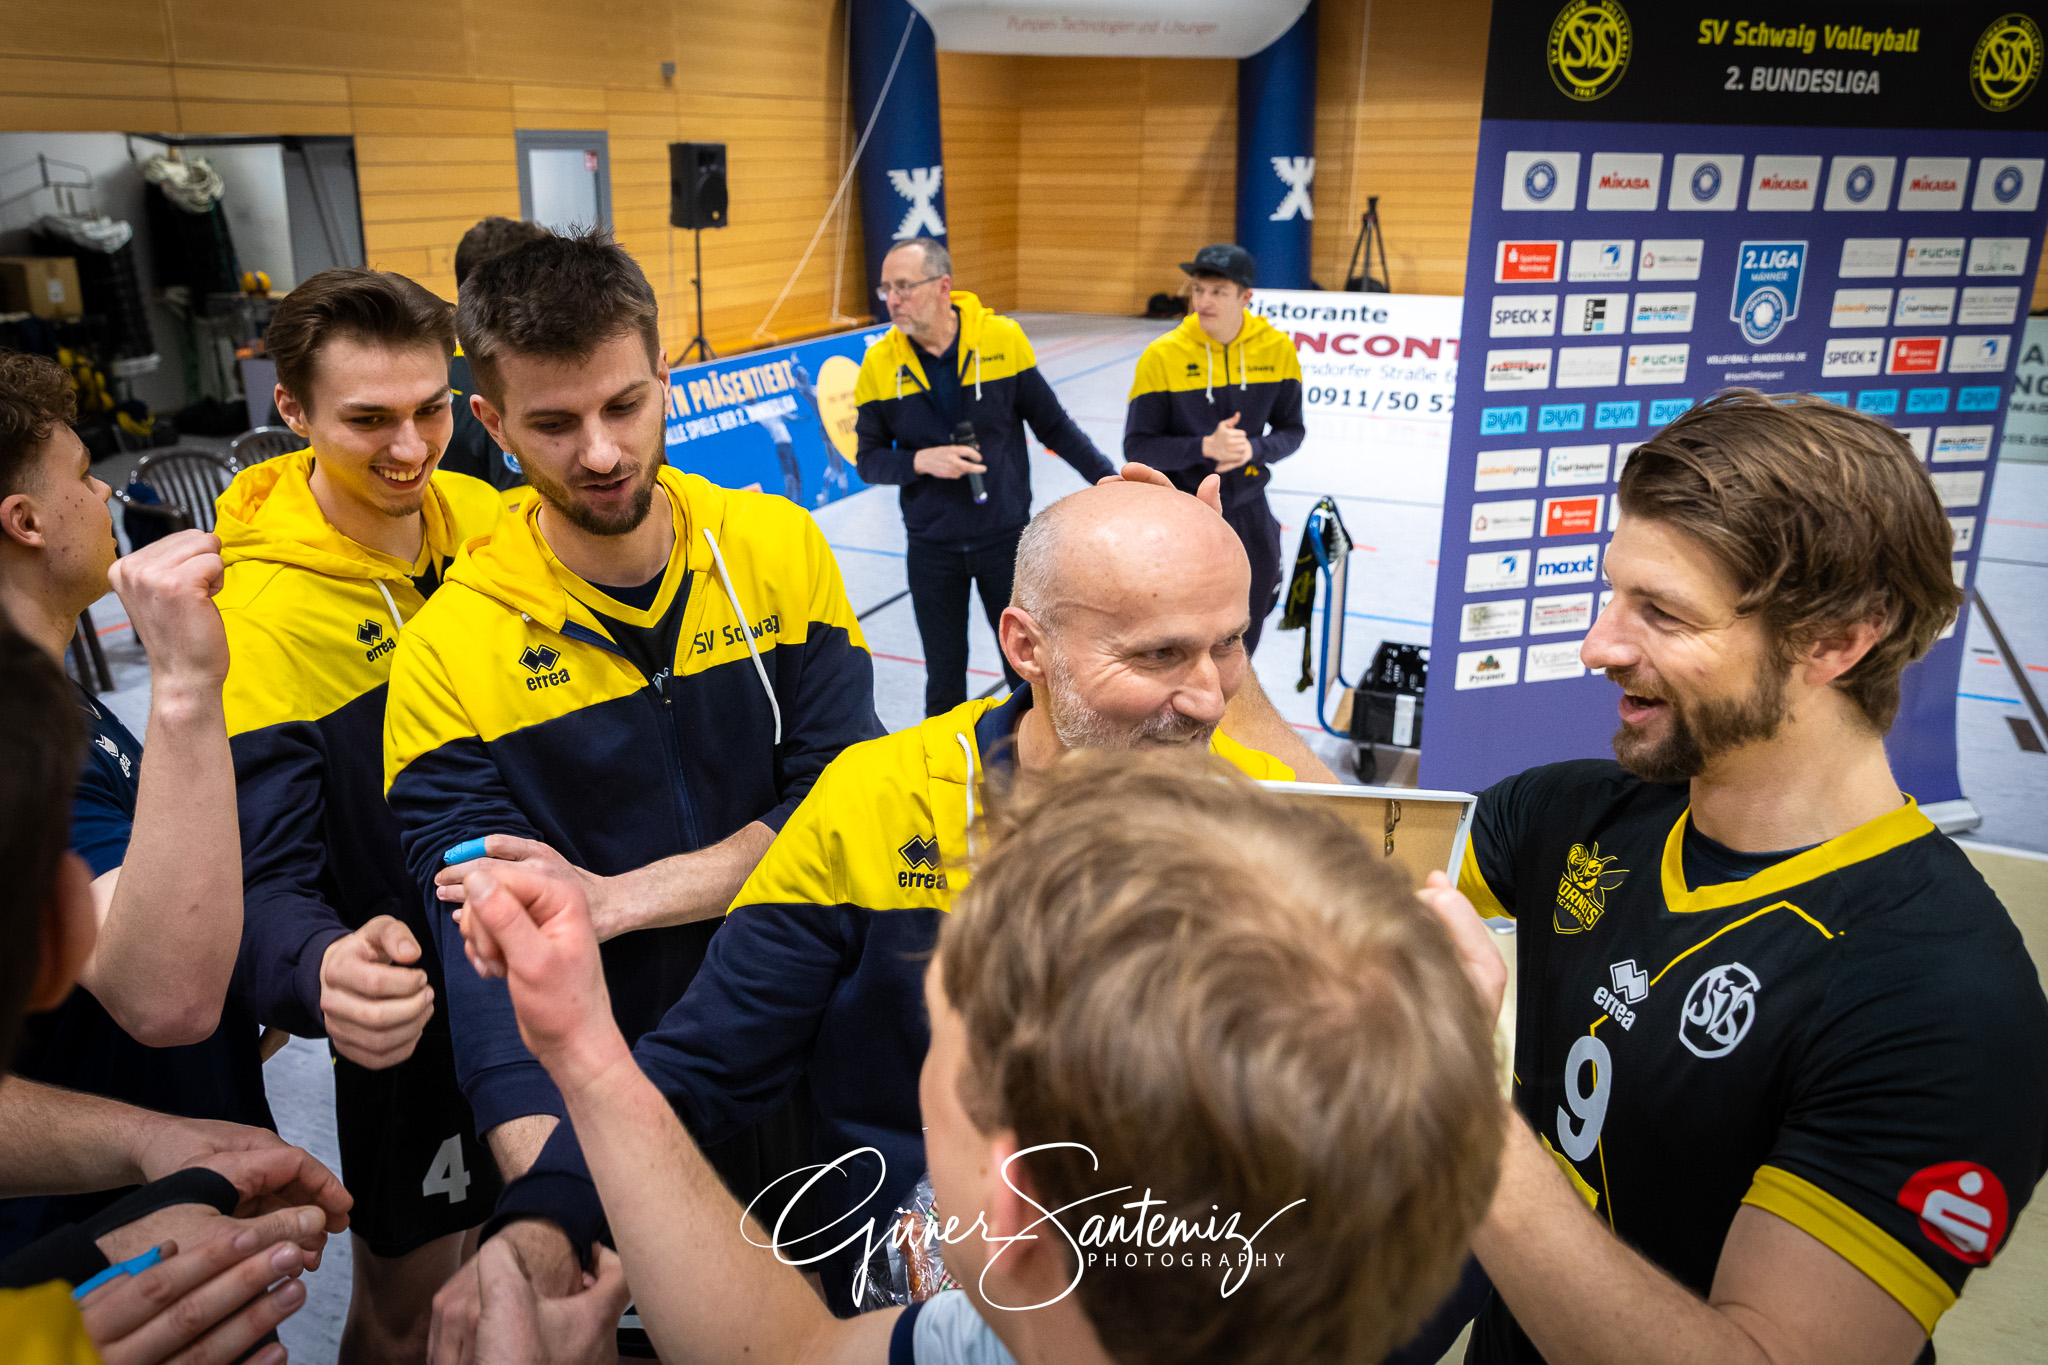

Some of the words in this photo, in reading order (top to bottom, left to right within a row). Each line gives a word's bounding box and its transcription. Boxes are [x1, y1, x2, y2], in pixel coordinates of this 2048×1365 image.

[1698, 18, 1730, 46] SV
[1733, 20, 1818, 54] Schwaig
[1824, 24, 1921, 56] Volleyball
[1723, 65, 1745, 91] 2.
[1750, 66, 1880, 94] BUNDESLIGA
[1247, 299, 1389, 322] istorante
[1495, 309, 1536, 325] SPECK
[1541, 309, 1553, 323] X
[1826, 350, 1864, 365] SPECK
[688, 359, 796, 413] PRÄSENTIERT
[1538, 556, 1594, 576] maxit
[365, 636, 397, 663] errea
[693, 629, 715, 655] SV
[525, 668, 571, 692] errea
[897, 870, 948, 890] errea
[1593, 986, 1637, 1031] errea
[1556, 1035, 1613, 1162] 9
[422, 1132, 471, 1204] 4
